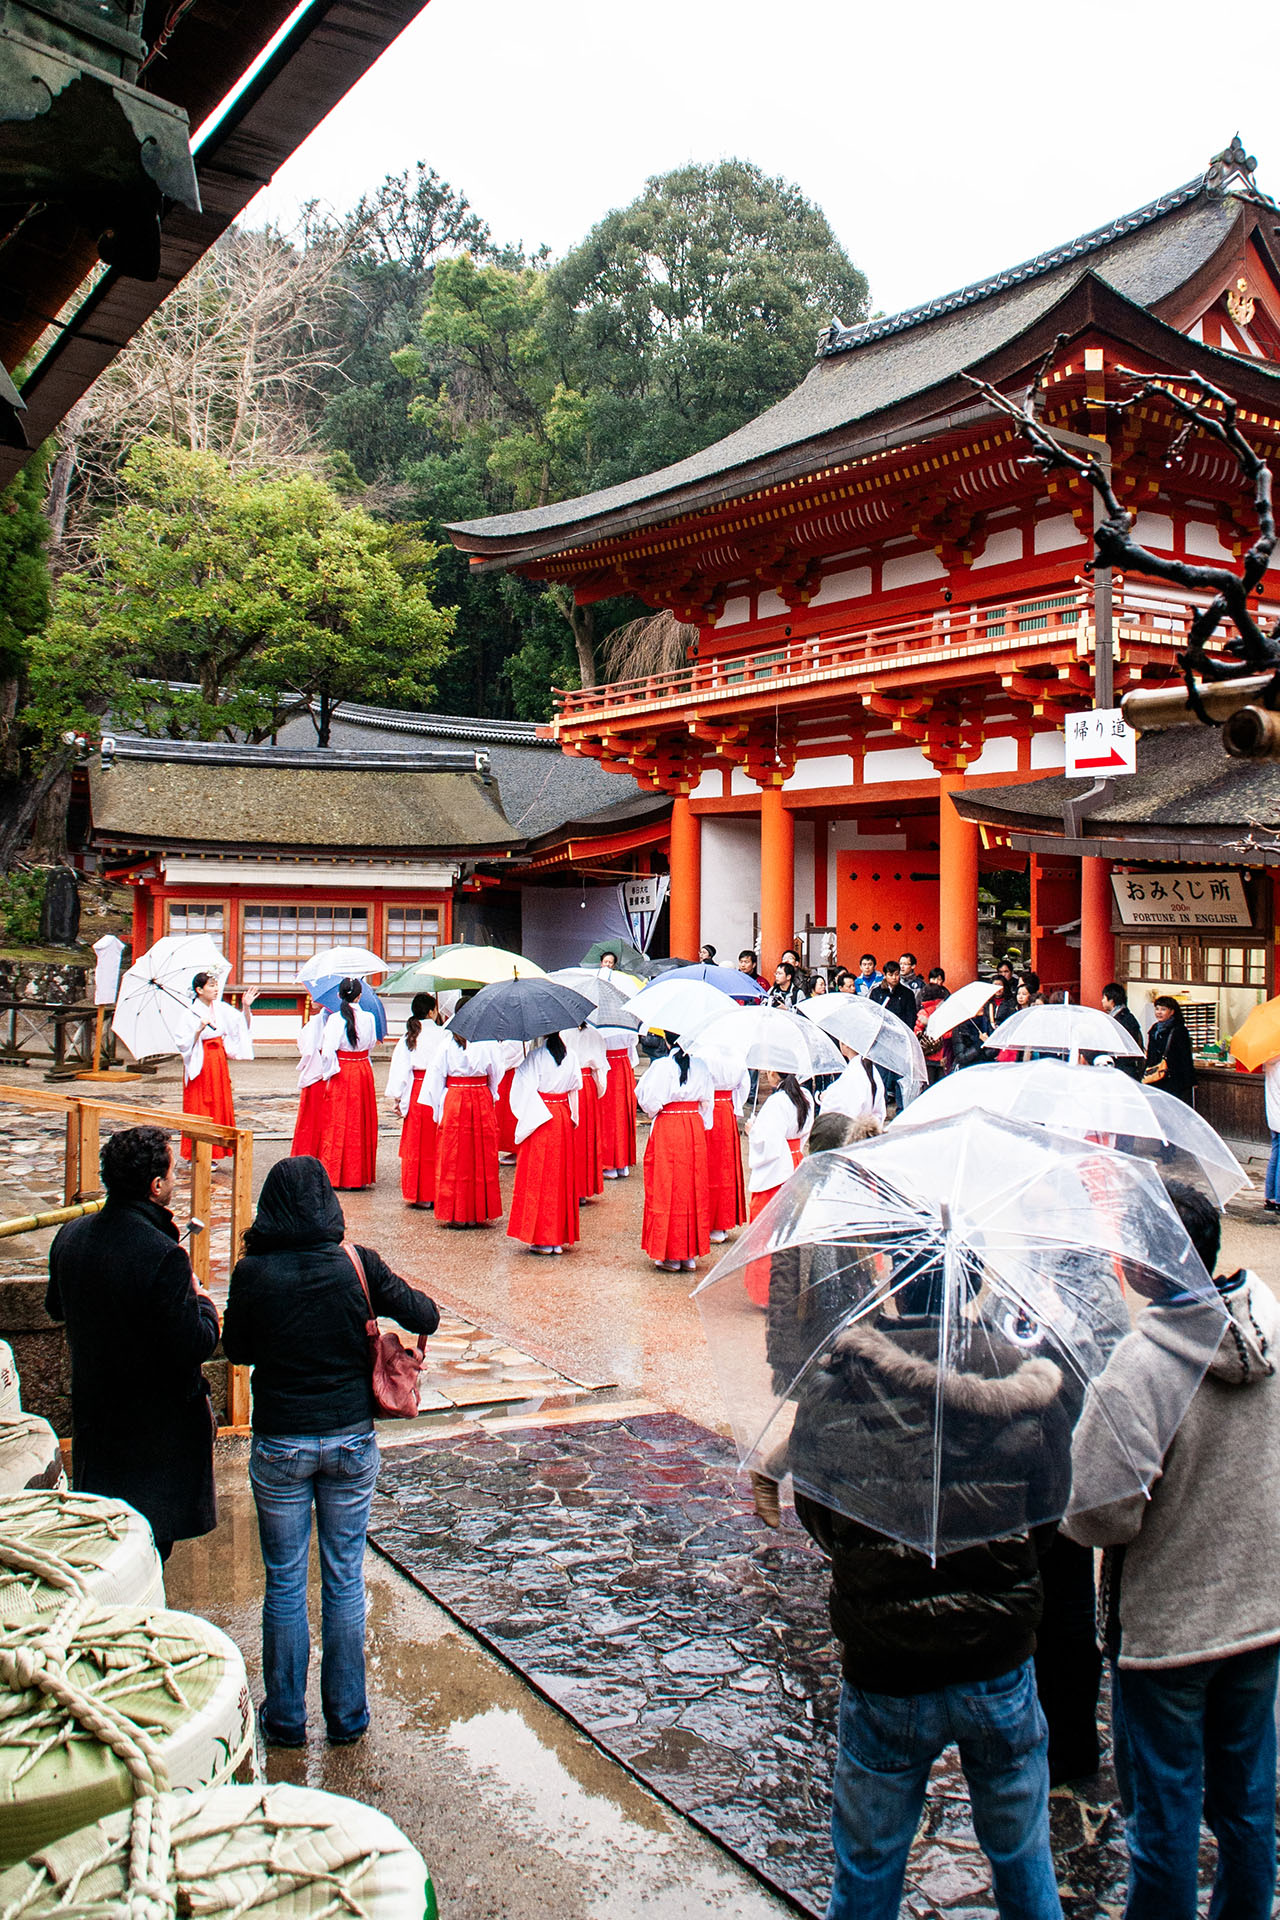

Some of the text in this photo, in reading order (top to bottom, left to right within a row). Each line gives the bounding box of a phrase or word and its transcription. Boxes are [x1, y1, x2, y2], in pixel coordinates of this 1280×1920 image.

[1073, 718, 1126, 741] 帰り道
[1126, 879, 1231, 901] おみくじ所
[1133, 913, 1238, 923] FORTUNE IN ENGLISH
